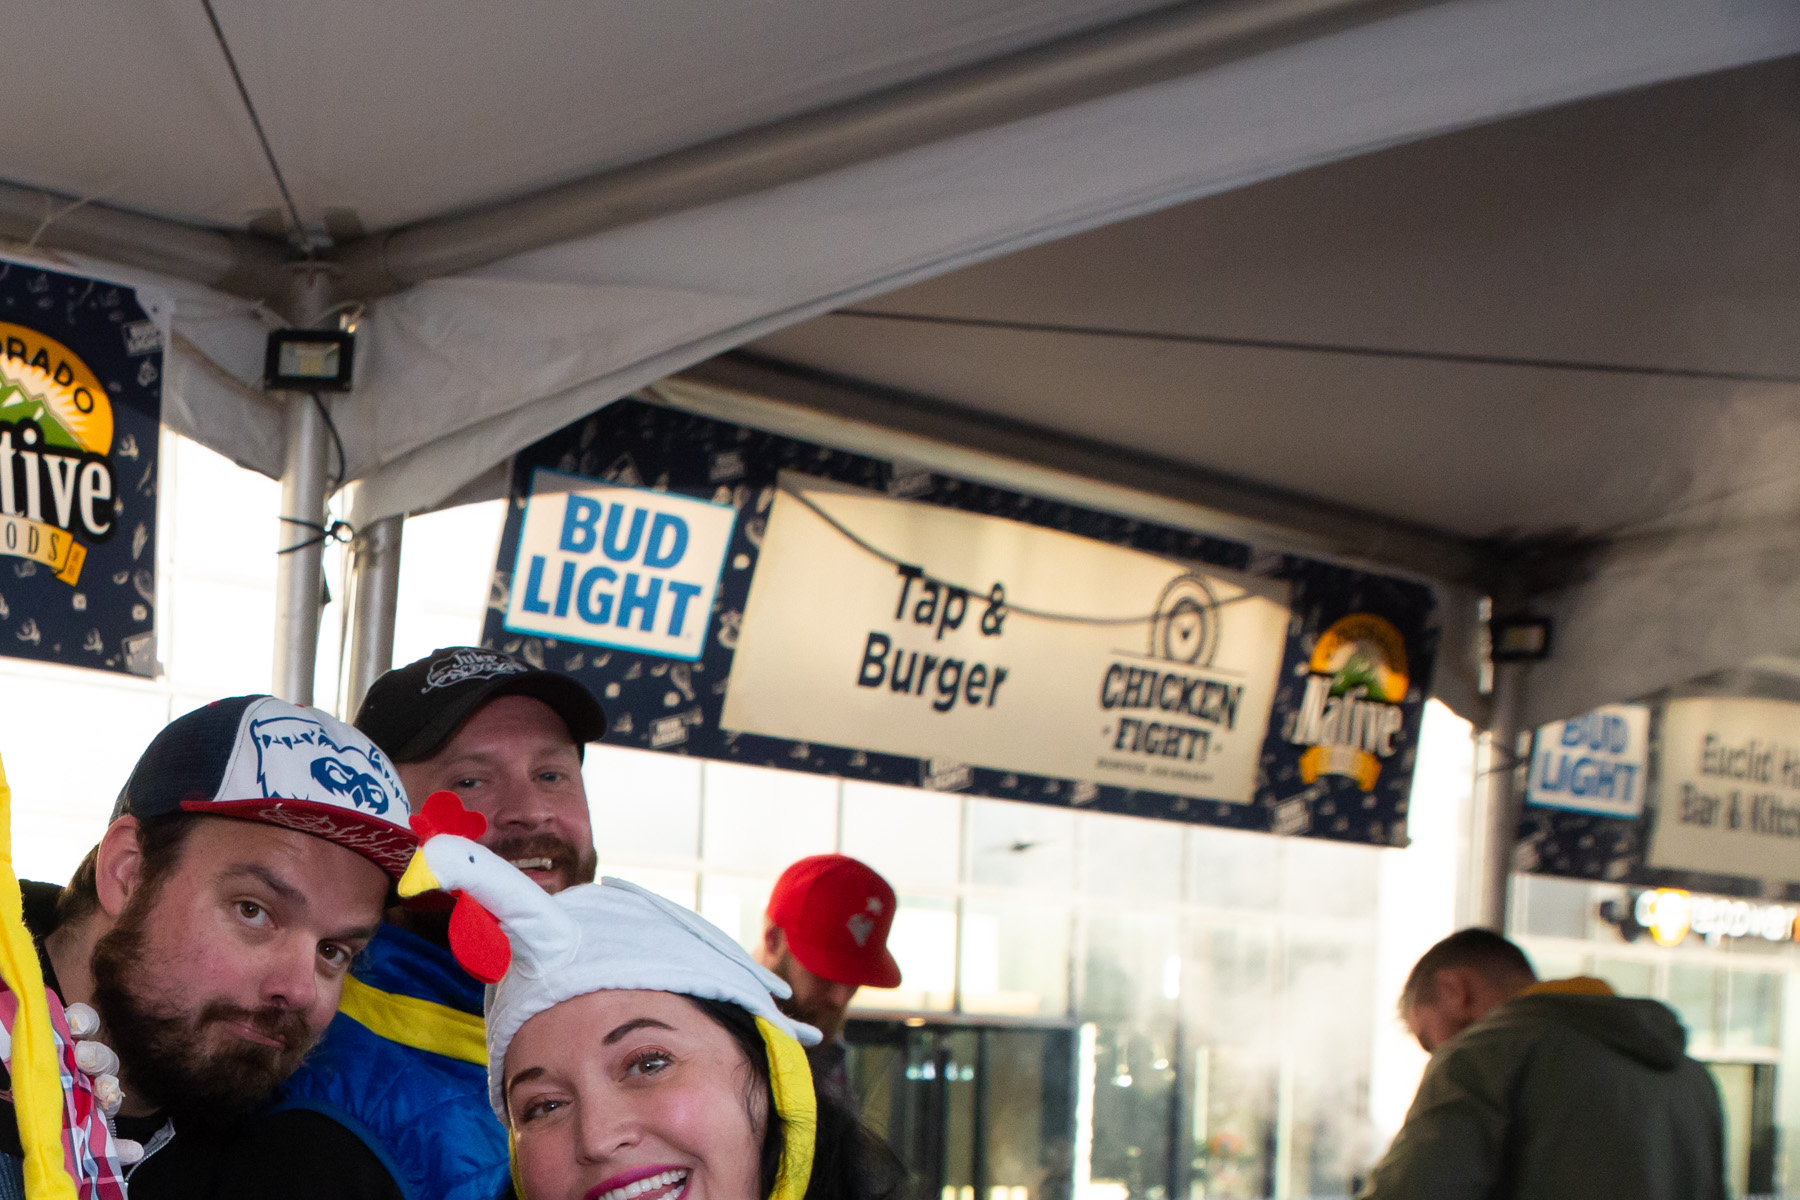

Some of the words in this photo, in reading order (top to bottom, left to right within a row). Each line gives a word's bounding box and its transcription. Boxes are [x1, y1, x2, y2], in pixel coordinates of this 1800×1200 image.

[558, 492, 690, 570] BUD
[521, 555, 703, 638] LIGHT
[893, 564, 969, 642] Tap
[980, 582, 1009, 637] &
[856, 632, 1010, 713] Burger
[1100, 662, 1244, 731] CHICKEN
[1561, 712, 1629, 755] BUD
[1540, 753, 1640, 802] LIGHT
